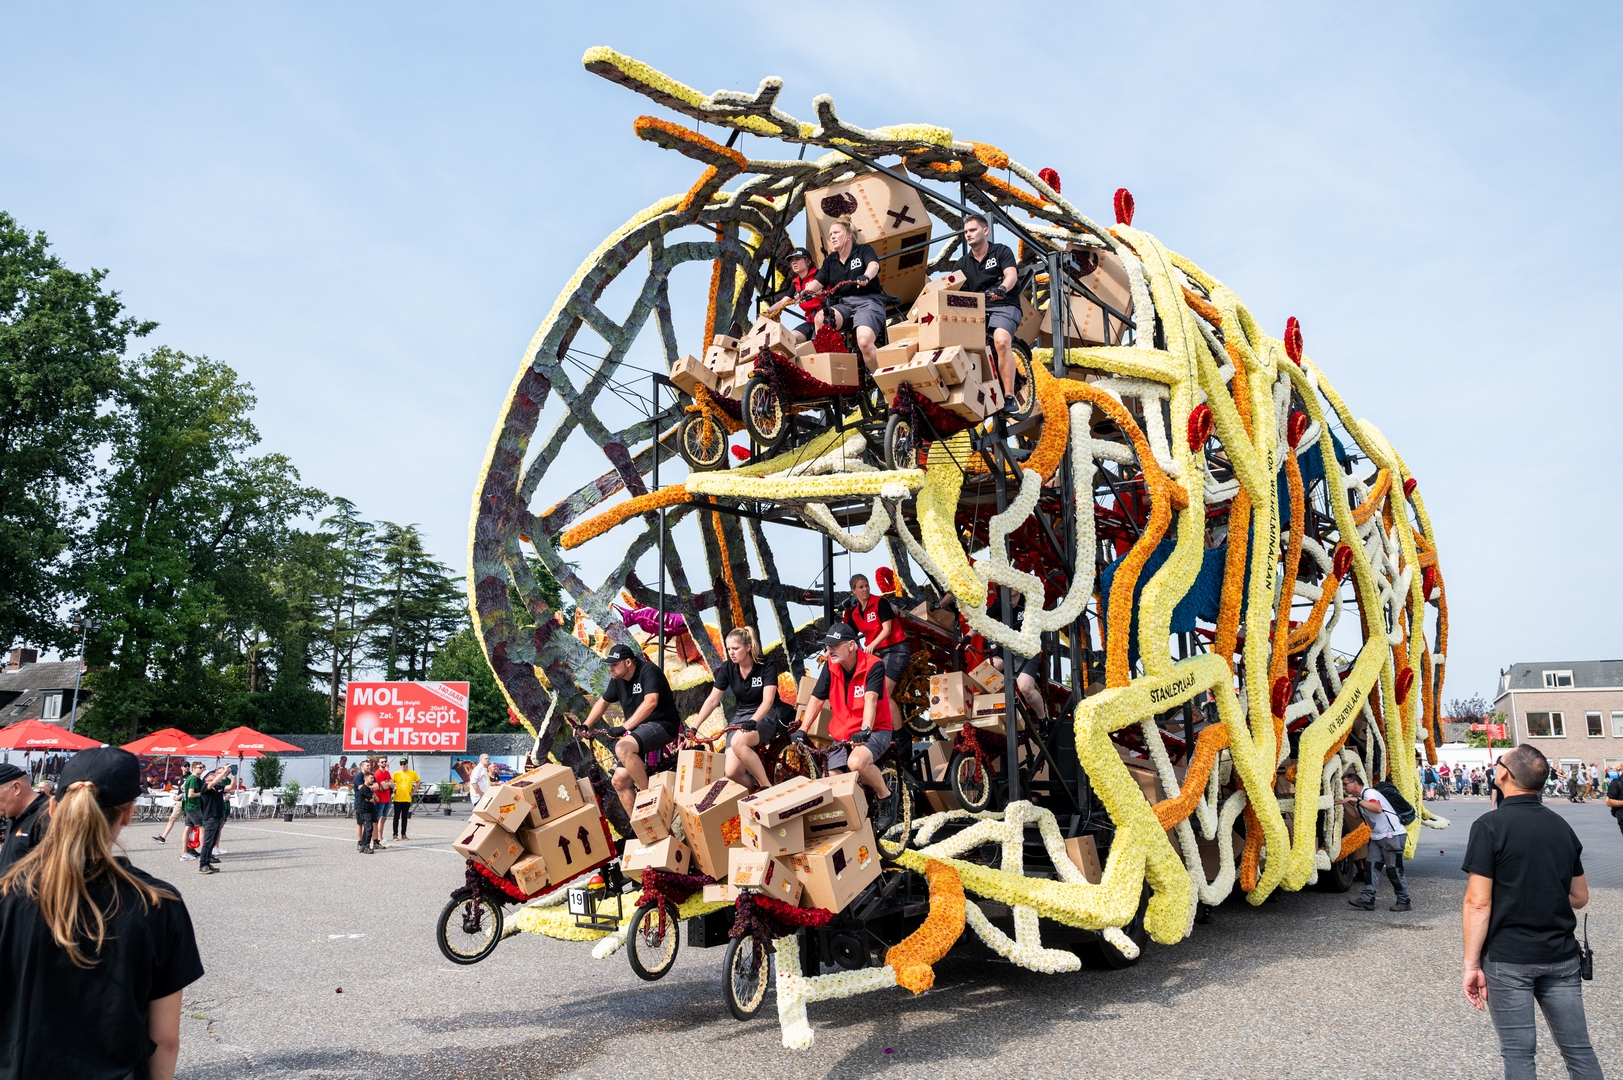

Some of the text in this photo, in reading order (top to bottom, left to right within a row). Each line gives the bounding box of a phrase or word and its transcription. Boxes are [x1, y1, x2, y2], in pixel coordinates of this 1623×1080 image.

[353, 687, 403, 706] MOL
[438, 685, 464, 702] 140 JAAR
[396, 707, 415, 724] 14
[416, 708, 461, 728] sept.
[570, 892, 583, 906] 19
